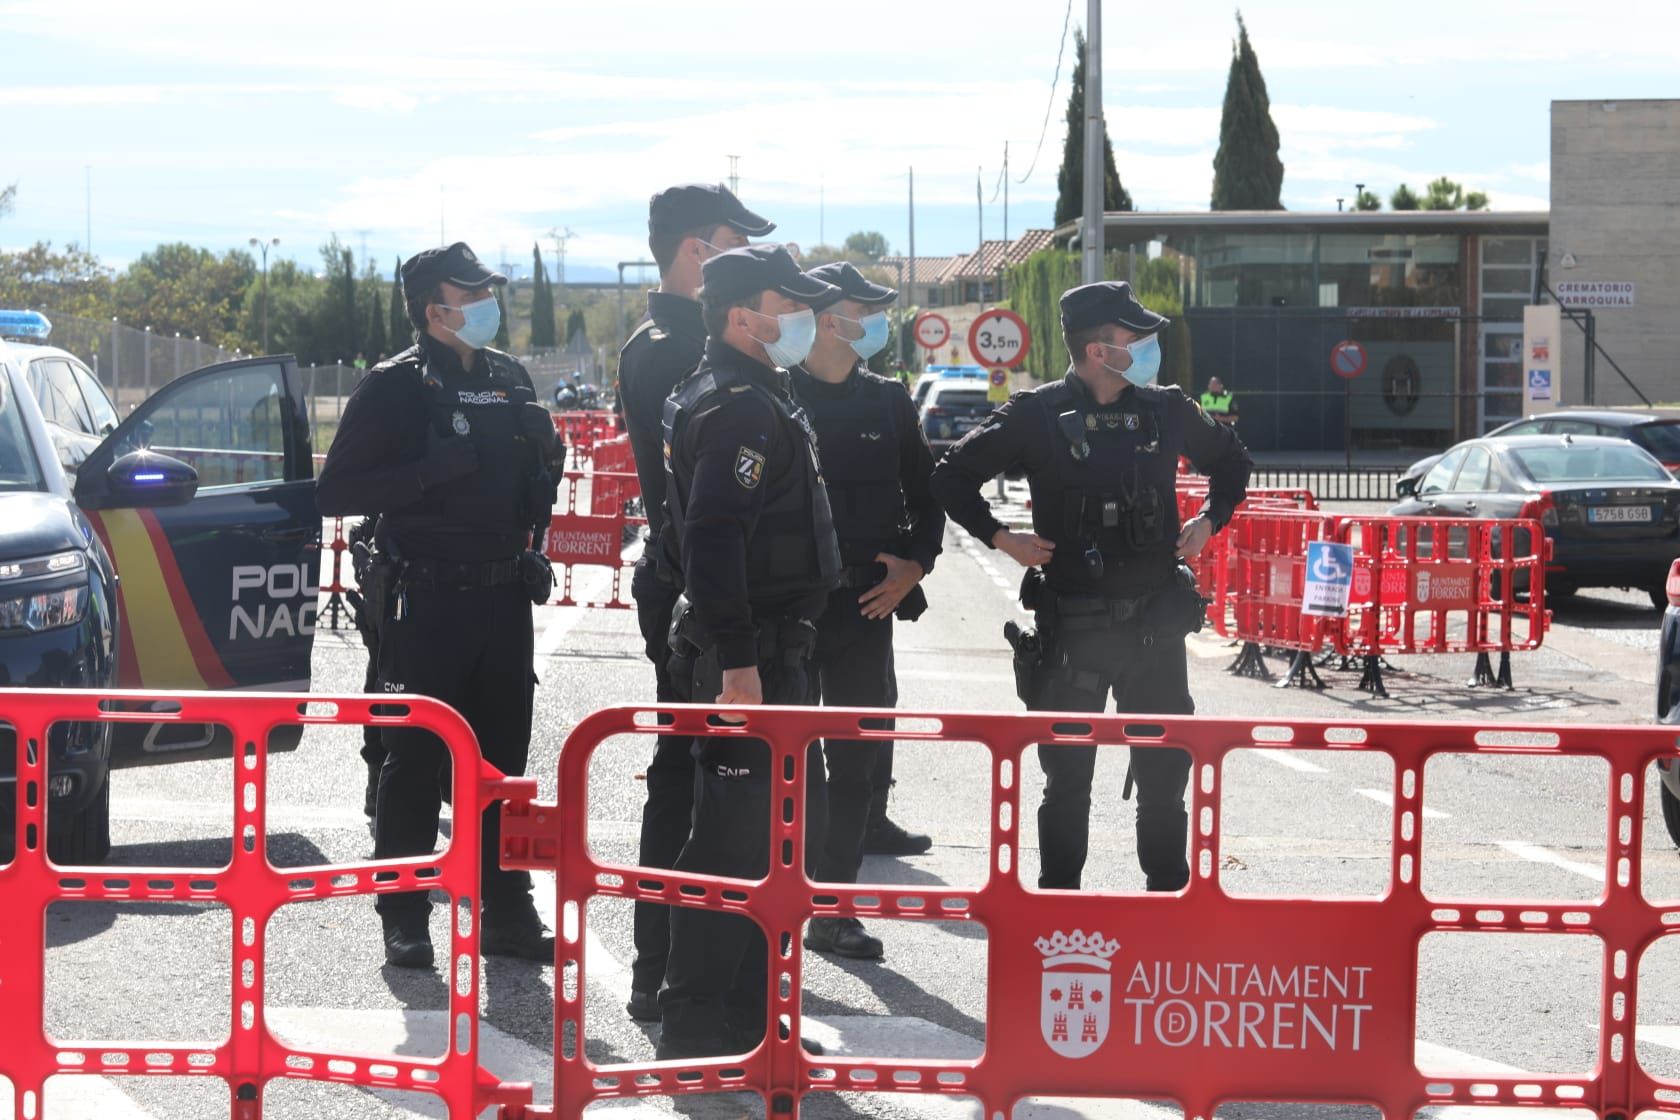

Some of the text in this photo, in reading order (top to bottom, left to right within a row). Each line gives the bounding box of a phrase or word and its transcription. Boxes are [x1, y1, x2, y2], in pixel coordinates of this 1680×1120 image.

[1558, 283, 1633, 293] CREMATORIO
[1558, 295, 1632, 305] PARROQUIAL
[552, 531, 612, 543] AJUNTAMENT
[552, 540, 612, 555] TORRENT
[1431, 577, 1470, 586] AJUNTAMENT
[1431, 586, 1470, 600] TORRENT
[384, 681, 405, 692] CNP
[717, 765, 750, 776] CNP
[1126, 960, 1373, 999] AJUNTAMENT
[1124, 998, 1373, 1051] TORRENT
